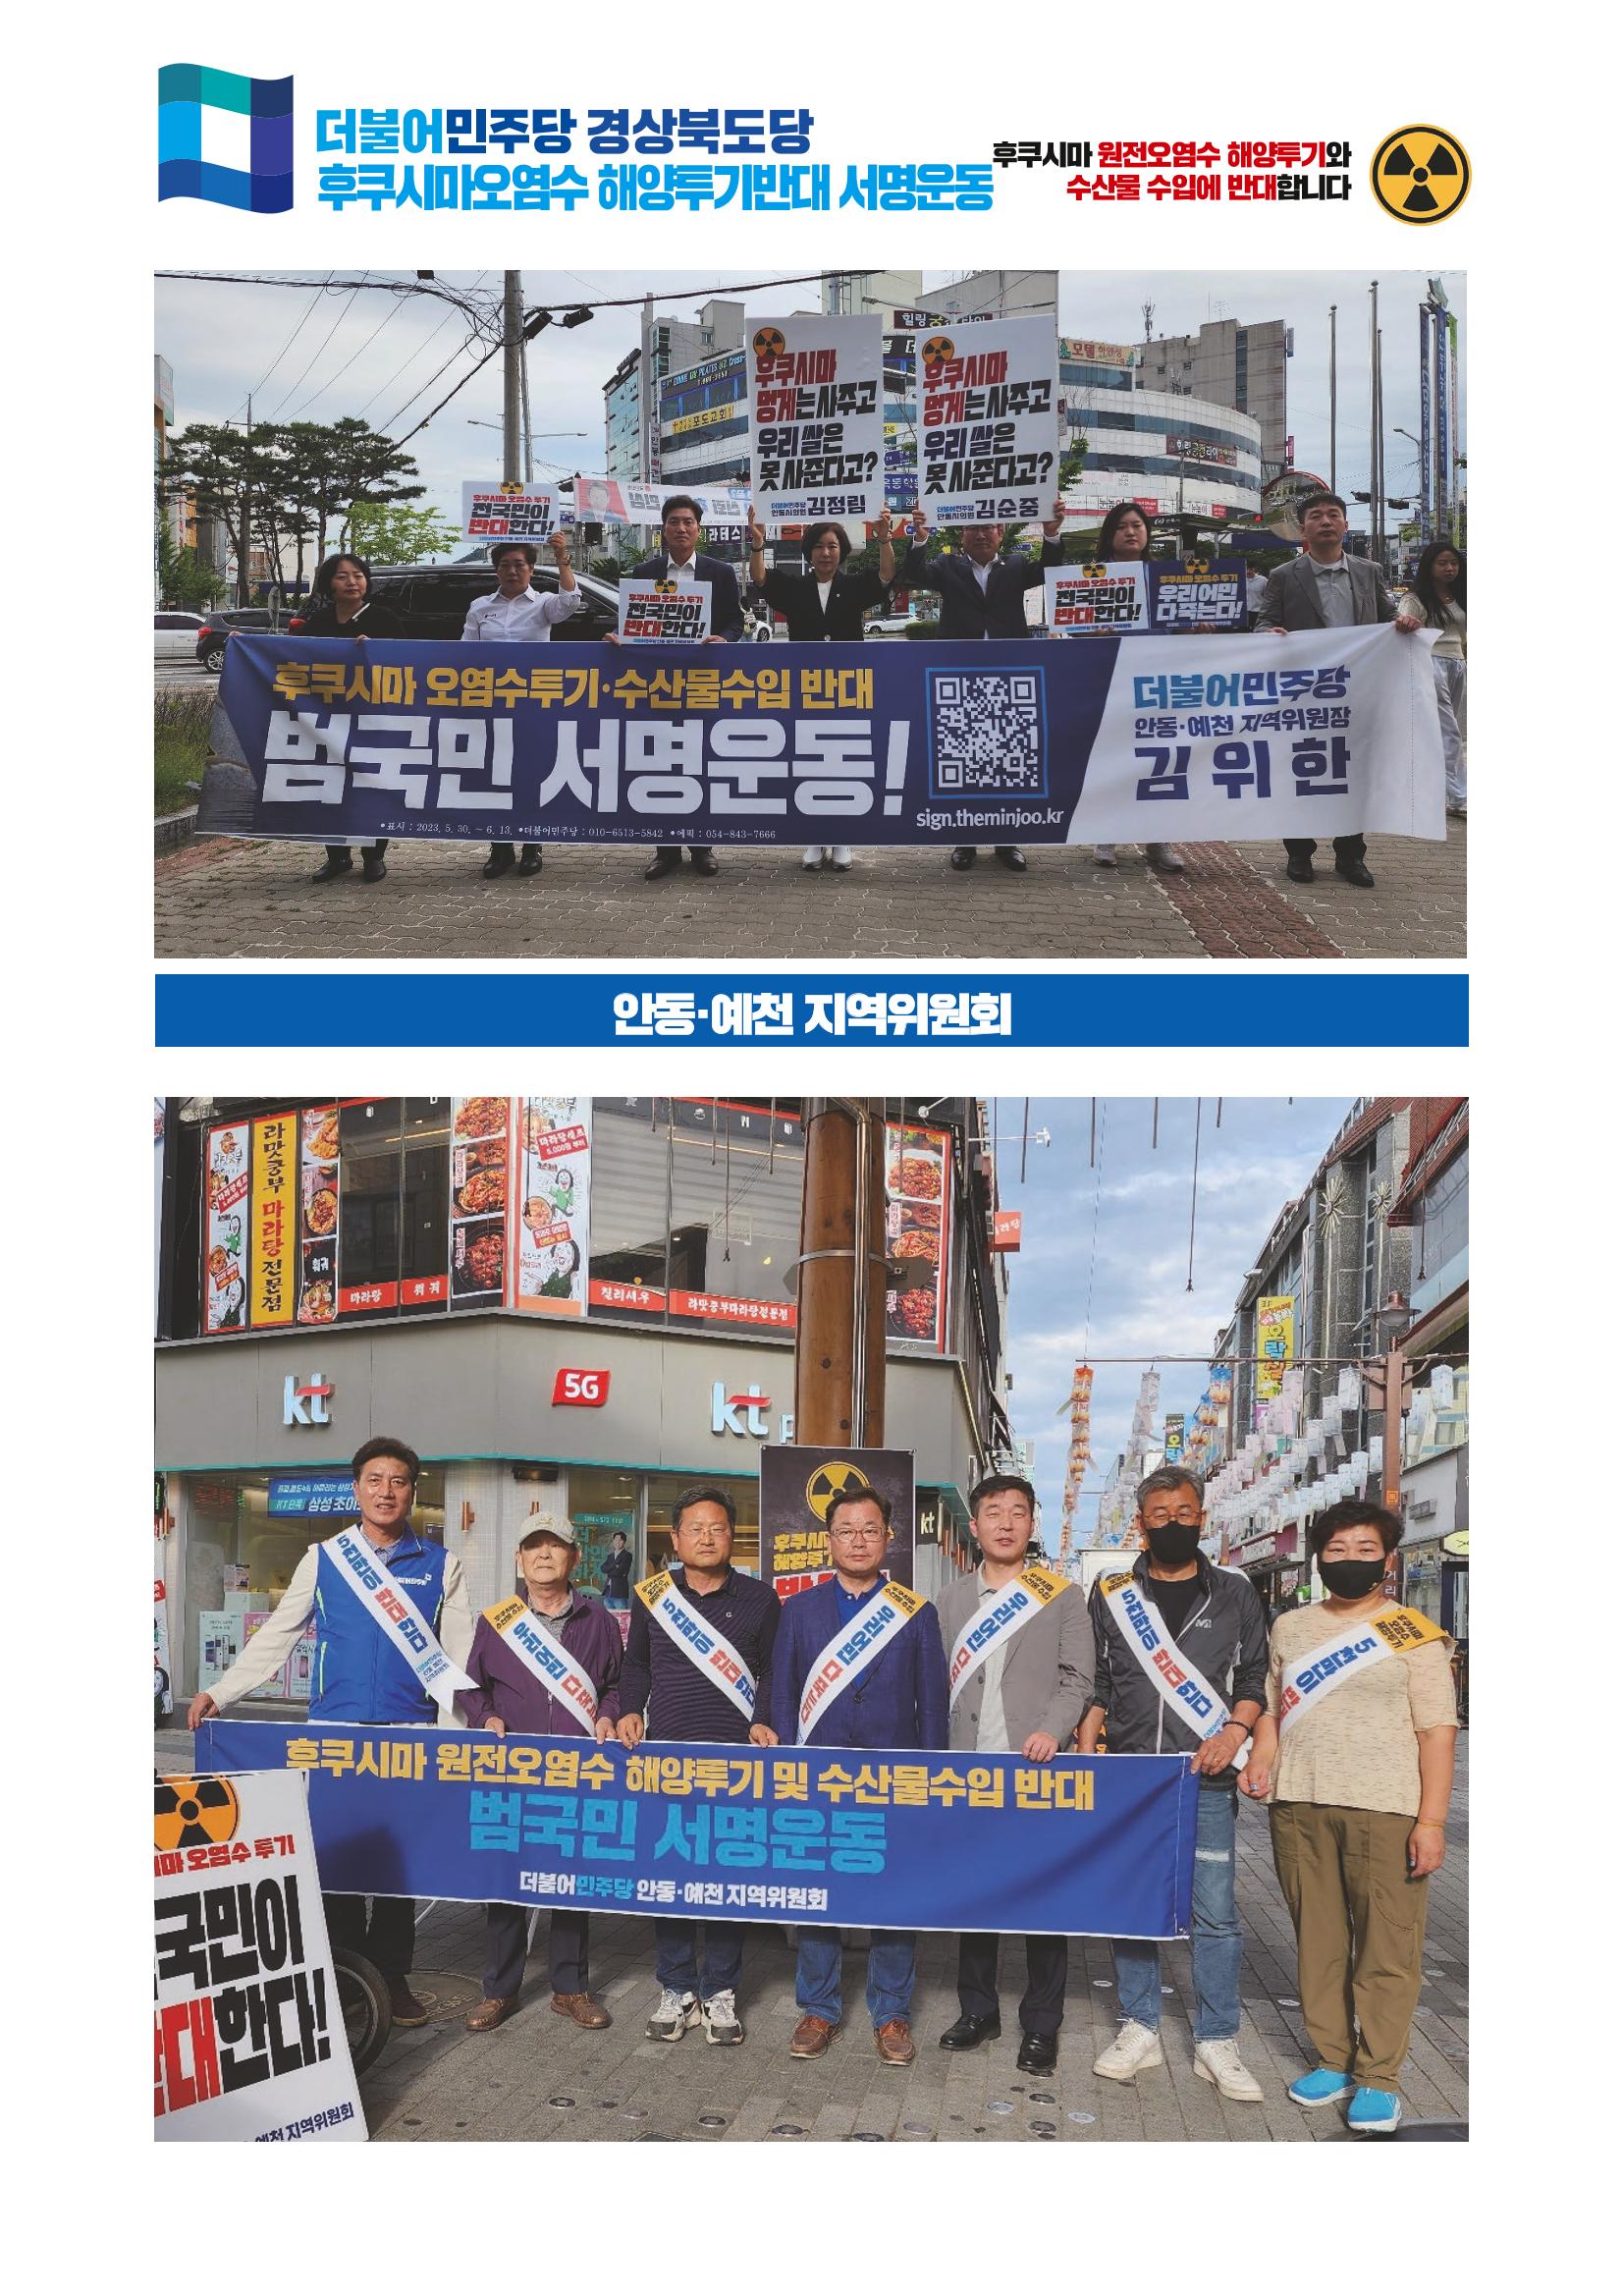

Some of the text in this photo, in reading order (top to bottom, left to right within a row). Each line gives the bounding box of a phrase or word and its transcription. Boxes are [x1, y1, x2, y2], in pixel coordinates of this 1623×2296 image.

[755, 349, 837, 388] 후쿠시마
[923, 351, 1007, 393] 후쿠시마
[757, 422, 843, 459] 우리 쌀은
[924, 422, 1015, 462] 우리 쌀은
[471, 502, 549, 519] 전국민이
[806, 494, 866, 517] 김정림
[975, 497, 1039, 519] 김순중
[467, 519, 555, 535] 반대한다!
[626, 602, 702, 621] 전국민이
[1055, 585, 1135, 607] 전국민이
[1157, 601, 1243, 622] 다죽는다!
[1158, 582, 1238, 603] 우리어민
[622, 620, 707, 638] 반대한다!
[1054, 604, 1142, 626] 반대한다!
[272, 661, 417, 705] 후쿠시마
[800, 669, 874, 709] 반대
[1133, 664, 1351, 709] 더불어민주당
[1134, 706, 1351, 738] 안동·예천 지역위원장
[262, 710, 911, 816] 범국민 서명운동!
[916, 807, 1064, 831] sign.theminjoo.kr
[261, 1199, 285, 1258] 마라탕
[261, 1259, 284, 1313] 전문점
[350, 1288, 382, 1305] 마라탕
[283, 1372, 336, 1427] kt
[564, 1373, 600, 1400] 5G
[711, 1381, 772, 1437] kt
[308, 1496, 333, 1512] 삼성
[333, 1495, 361, 1511] 초이
[920, 1509, 936, 1535] kt
[374, 1586, 429, 1654] 반대한다
[661, 1598, 716, 1656] 5천만이
[836, 1604, 895, 1667] 우리어민
[965, 1591, 1029, 1654] 우리어민
[513, 1621, 568, 1681] 우리어민
[1121, 1588, 1214, 1720] 5천만이 반대한다
[1295, 1636, 1379, 1695] 5천만이
[286, 1737, 1095, 1811] 후쿠시마 원전오염수 해양투기 및 수산물수입 반대
[187, 1840, 252, 1872] 오염수
[253, 1833, 296, 1860] 투기
[467, 1790, 888, 1875] 범국민 서명운동
[518, 1870, 829, 1912] 더불어민주당 안동·예천 지역위원회
[154, 1874, 305, 1991] 국민이
[154, 1967, 332, 2117] 대한다!
[286, 2102, 354, 2142] 지역위원회
